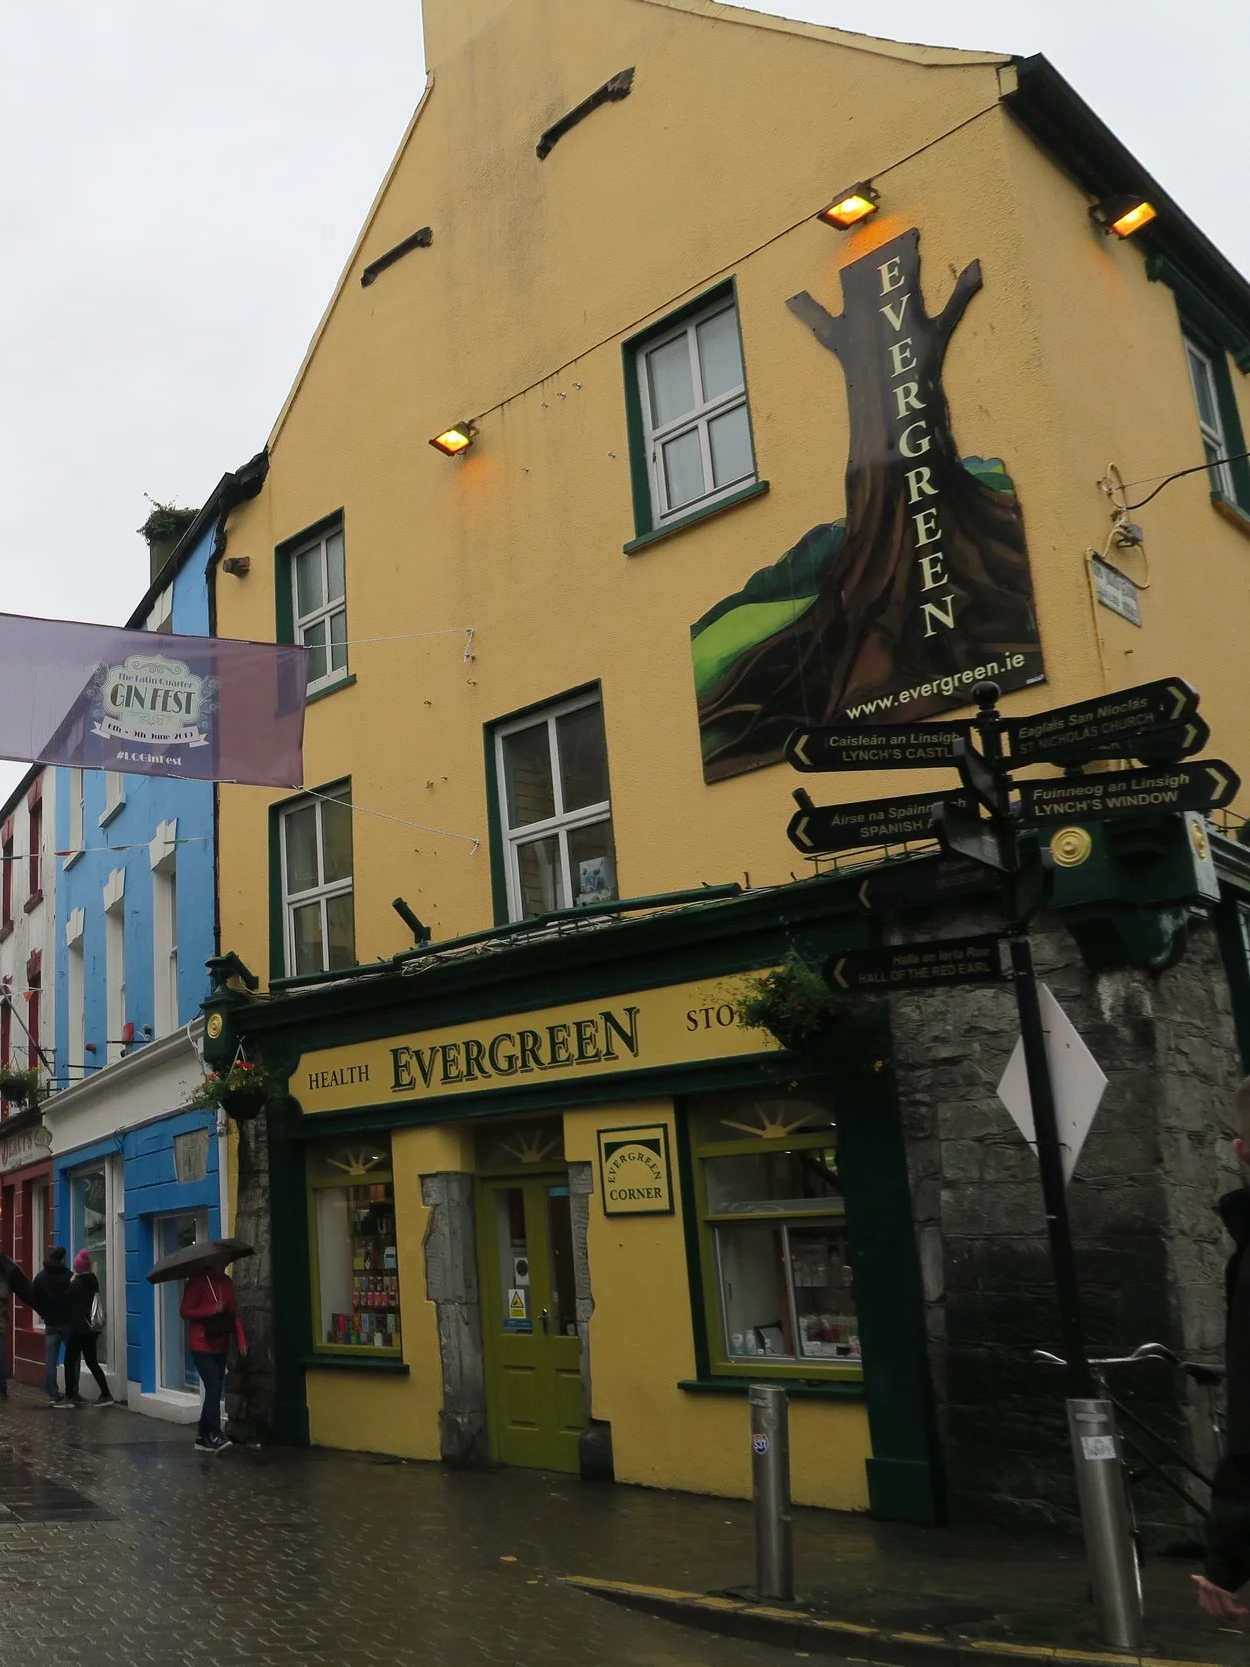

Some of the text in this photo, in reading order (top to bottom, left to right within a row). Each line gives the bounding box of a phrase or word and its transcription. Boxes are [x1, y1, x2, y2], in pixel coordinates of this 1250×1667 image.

[876, 254, 956, 638] EVERGREEN
[110, 684, 196, 714] GIN FEST
[846, 652, 1026, 720] www.evergreen.ie
[1019, 698, 1148, 740] Eaglais San Nioclás
[1102, 712, 1154, 734] CHURCH
[890, 736, 906, 744] an
[842, 746, 955, 762] LYNCH'S CASTL
[1033, 774, 1190, 800] Fuinneog an Linsigh
[1034, 790, 1179, 816] LYNCH'S WINDOW
[860, 820, 923, 838] SPANISH
[868, 812, 886, 822] na
[858, 962, 992, 984] HALL OF THE RED EARL
[308, 1004, 735, 1093] HEALTH EVERGREEN STO
[608, 1152, 662, 1184] EVERGREEN
[609, 1187, 662, 1202] CORNER
